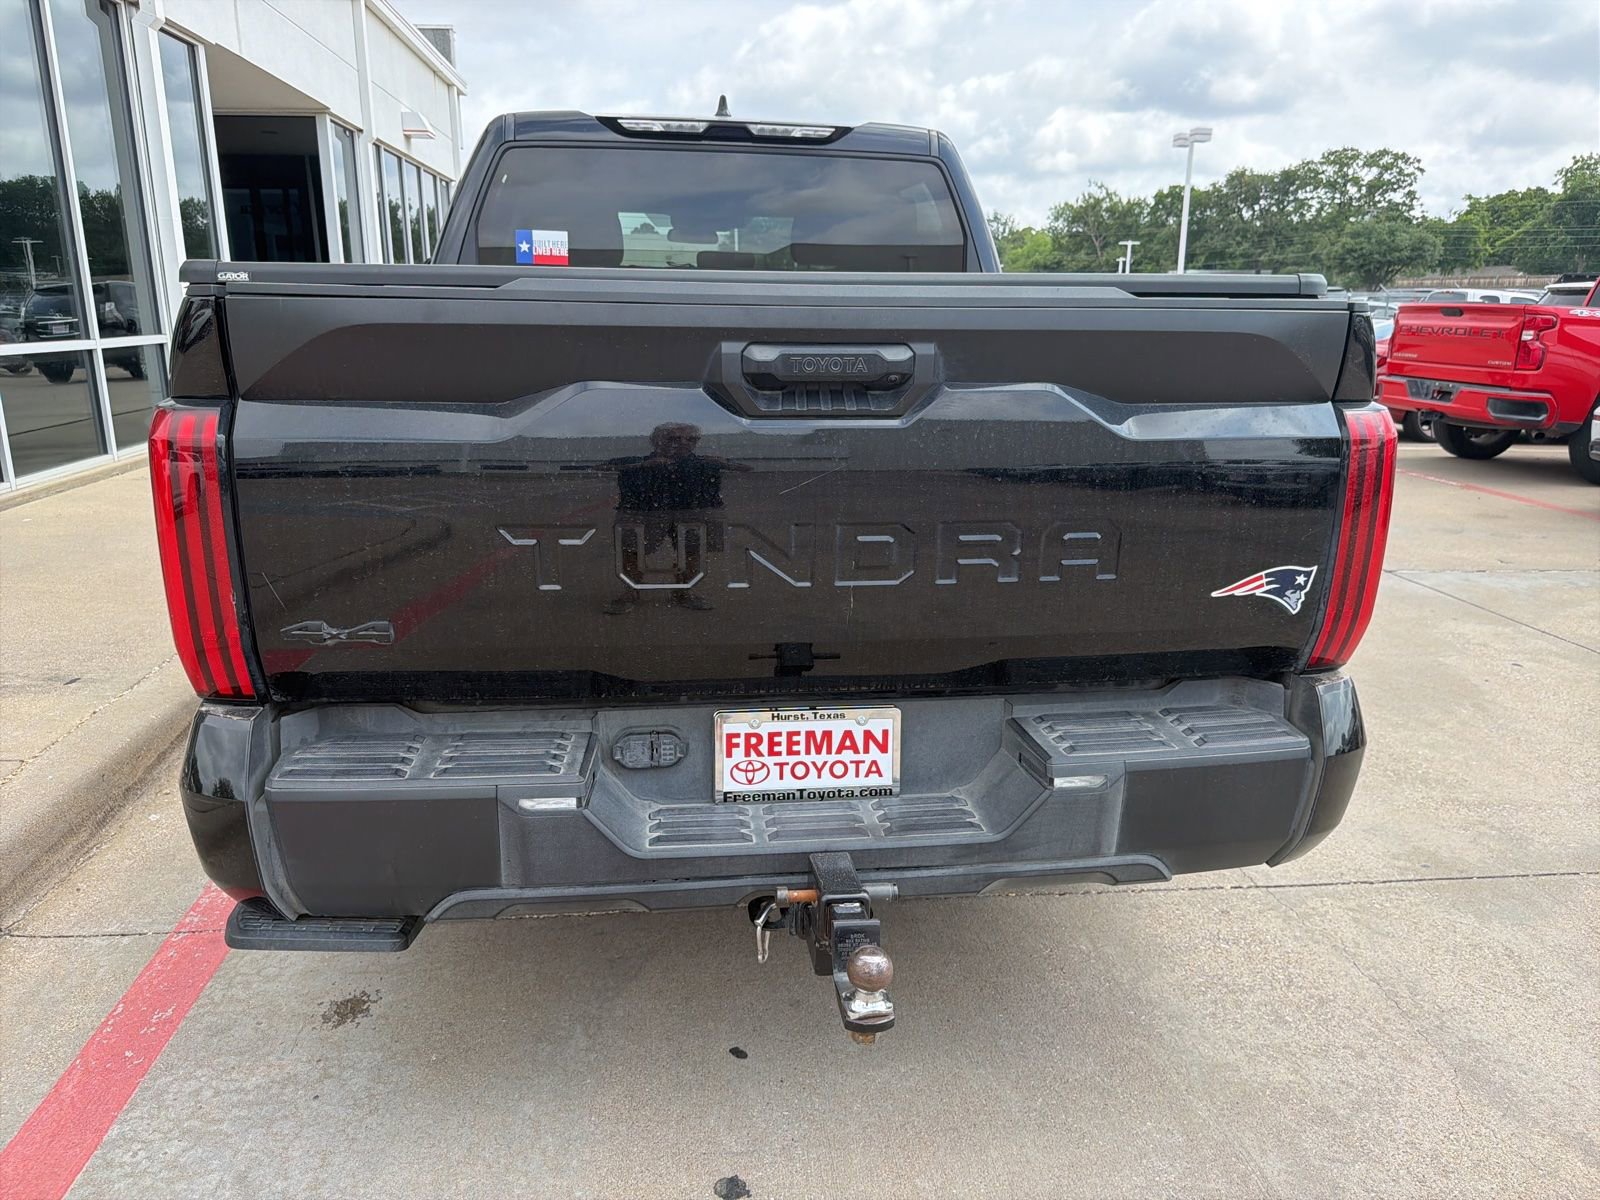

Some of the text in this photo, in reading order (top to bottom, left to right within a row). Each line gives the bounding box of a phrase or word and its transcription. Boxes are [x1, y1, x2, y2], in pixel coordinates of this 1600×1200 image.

[552, 247, 568, 256] HERE
[217, 272, 249, 281] GATOR
[1399, 324, 1505, 340] CHEVROLET
[790, 356, 868, 373] TOYOTA
[495, 519, 1123, 590] TUNDRA
[771, 711, 846, 721] Hurst, Texas
[725, 729, 889, 759] FREEMAN
[773, 759, 884, 781] TOYOTA
[723, 787, 893, 803] FreemanToyota.com
